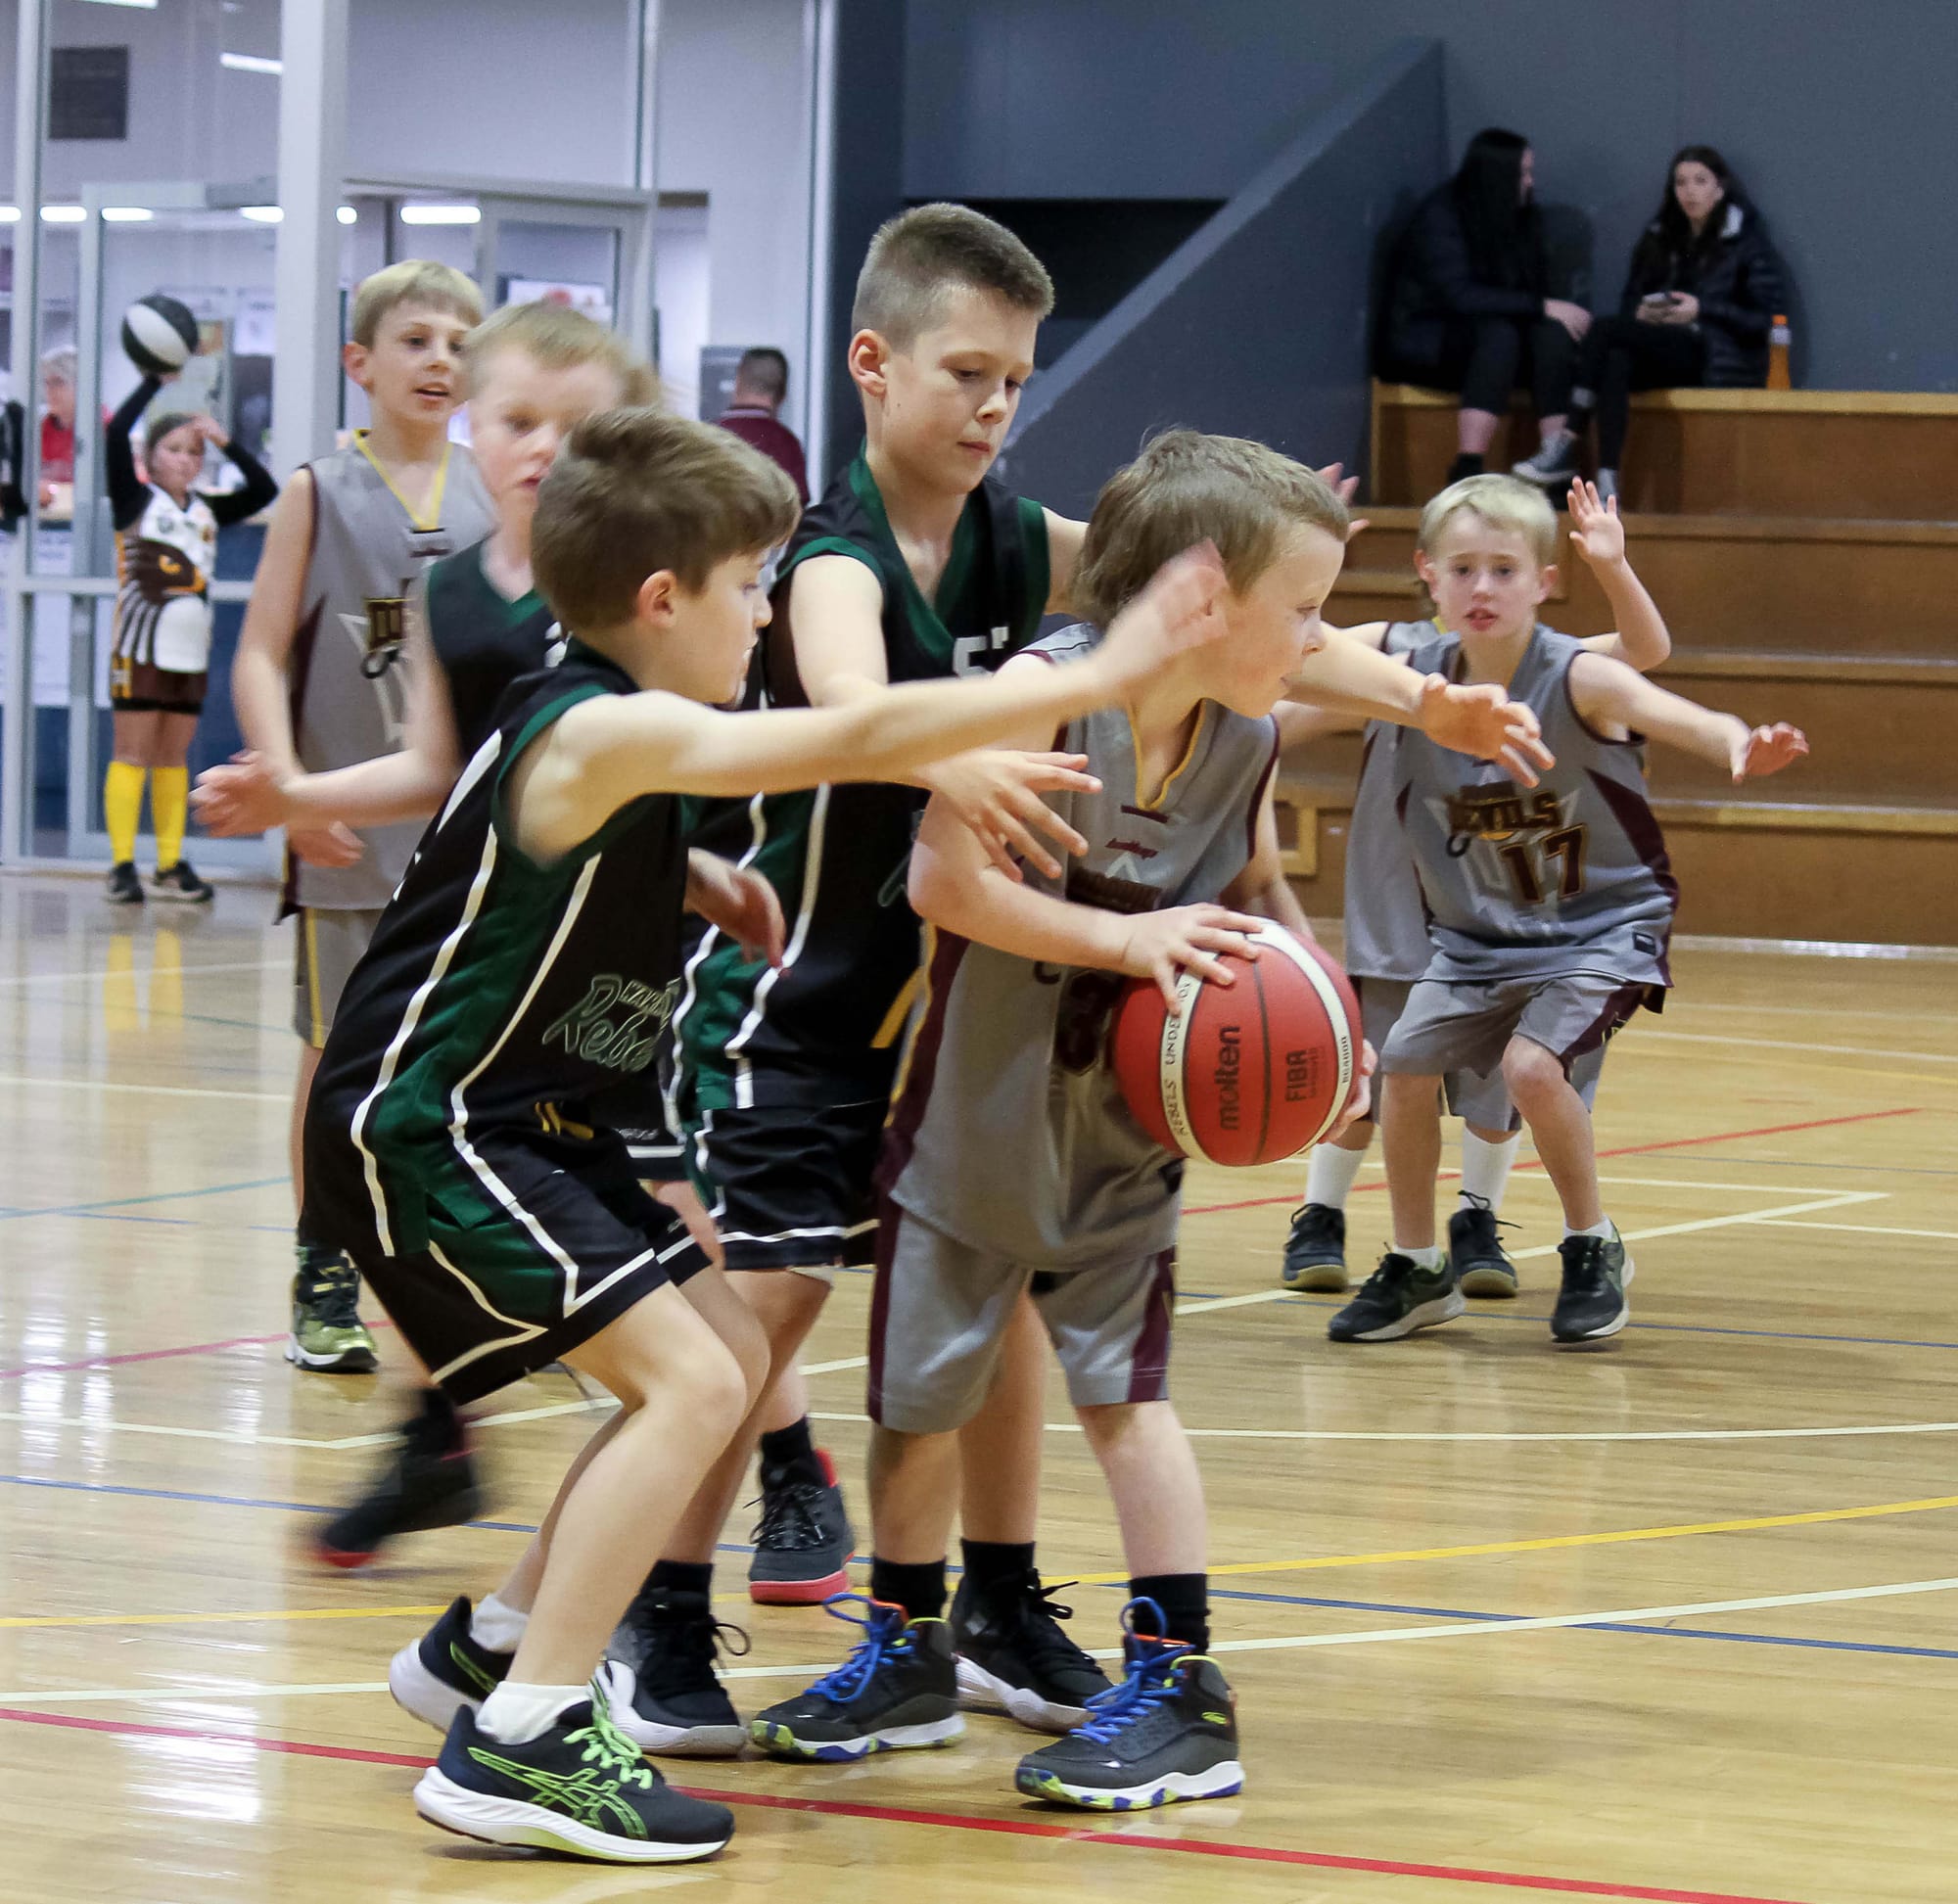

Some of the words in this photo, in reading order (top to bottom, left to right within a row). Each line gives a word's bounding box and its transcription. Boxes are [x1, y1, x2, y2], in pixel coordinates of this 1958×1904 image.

[1498, 823, 1588, 905] 17
[1164, 1015, 1182, 1066] UNDE
[1214, 1025, 1241, 1131] molten
[1284, 1049, 1308, 1103] FIBA
